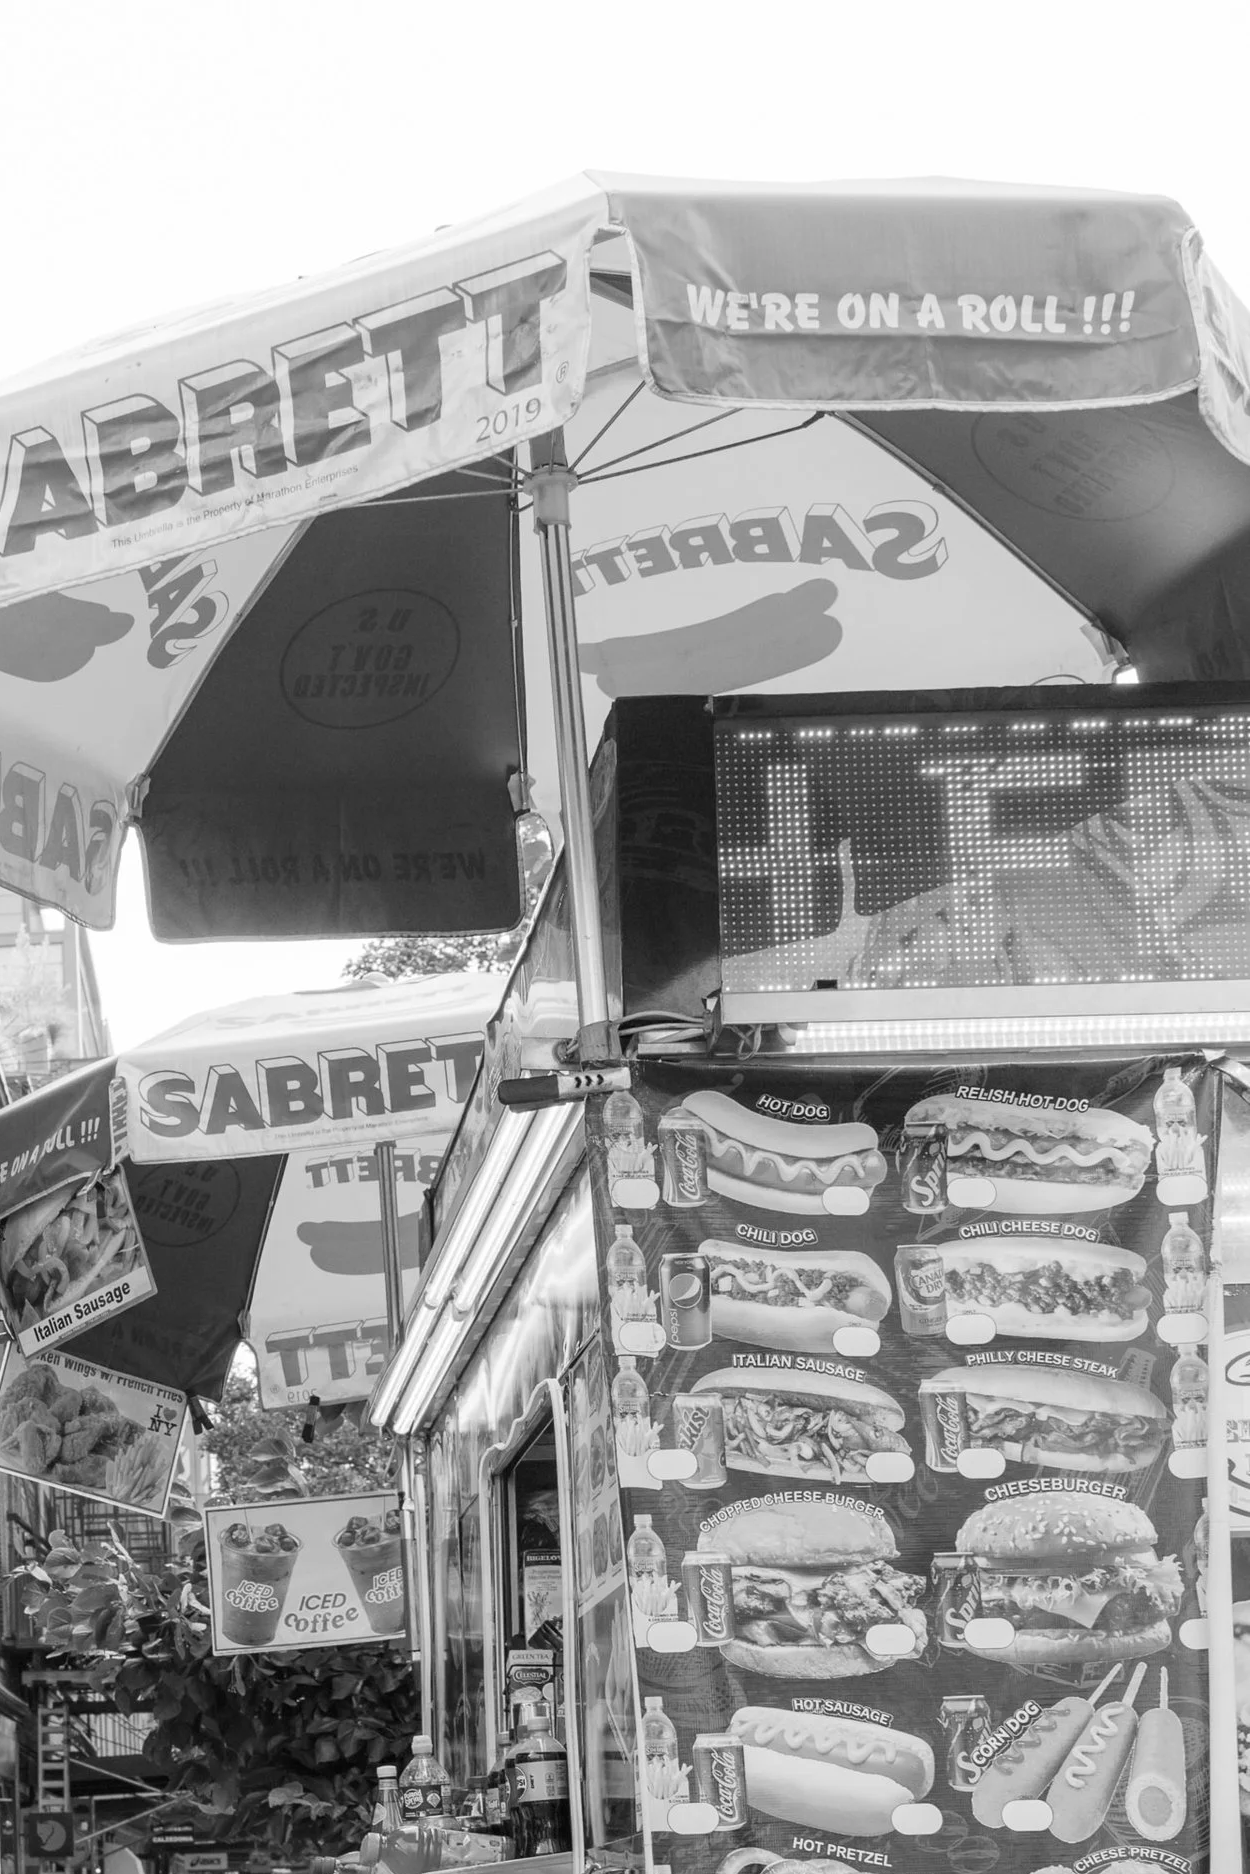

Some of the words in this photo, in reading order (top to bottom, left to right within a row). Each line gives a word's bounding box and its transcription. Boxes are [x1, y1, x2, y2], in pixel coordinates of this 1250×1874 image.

[687, 283, 820, 331] WE'RE
[837, 292, 899, 329] ON
[916, 293, 946, 329] A
[958, 294, 1067, 334] ROLL
[1082, 291, 1135, 336] !!!
[475, 397, 544, 445] 2019
[111, 534, 133, 550] This
[134, 521, 174, 543] Umbrella
[186, 512, 202, 527] the
[203, 500, 243, 522] Property
[257, 482, 302, 502] Marathon
[304, 464, 359, 489] Enterprises
[757, 1094, 790, 1116] HOT
[792, 1103, 830, 1121] DOG
[956, 1085, 1016, 1105] RELISH
[1018, 1092, 1051, 1109] HOT
[1053, 1096, 1090, 1113] DOG
[10, 1153, 27, 1177] ON
[28, 1144, 40, 1166] A
[736, 1224, 776, 1244] CHILI
[780, 1229, 817, 1245] DOG
[960, 1222, 998, 1240] CHILI
[1001, 1220, 1060, 1235] CHEESE
[1063, 1224, 1099, 1242] DOG
[33, 1310, 73, 1342] Italian
[74, 1279, 131, 1323] Sausage
[670, 1308, 682, 1344] pepsi
[732, 1353, 792, 1369] ITALIAN
[796, 1356, 866, 1383] SAUSAGE
[966, 1351, 1015, 1367] PHILLY
[1017, 1351, 1070, 1367] CHEESE
[1073, 1358, 1120, 1379] STEAK
[147, 1416, 178, 1437] NY
[985, 1478, 1127, 1501] CHEESEBURGER
[699, 1497, 761, 1534] CHOPPED
[764, 1491, 822, 1506] CHEESE
[825, 1492, 885, 1520] BURGER
[237, 1580, 274, 1599] ICED
[299, 1592, 347, 1611] ICED
[793, 1699, 822, 1712] HOT
[824, 1701, 891, 1725] SAUSAGE
[971, 1727, 1011, 1765] CORN
[1006, 1701, 1041, 1735] DOG
[792, 1837, 825, 1854] HOT
[827, 1844, 893, 1867] PRETZEL
[1075, 1847, 1127, 1873] CHEESE
[1131, 1847, 1190, 1874] PRETZEL
